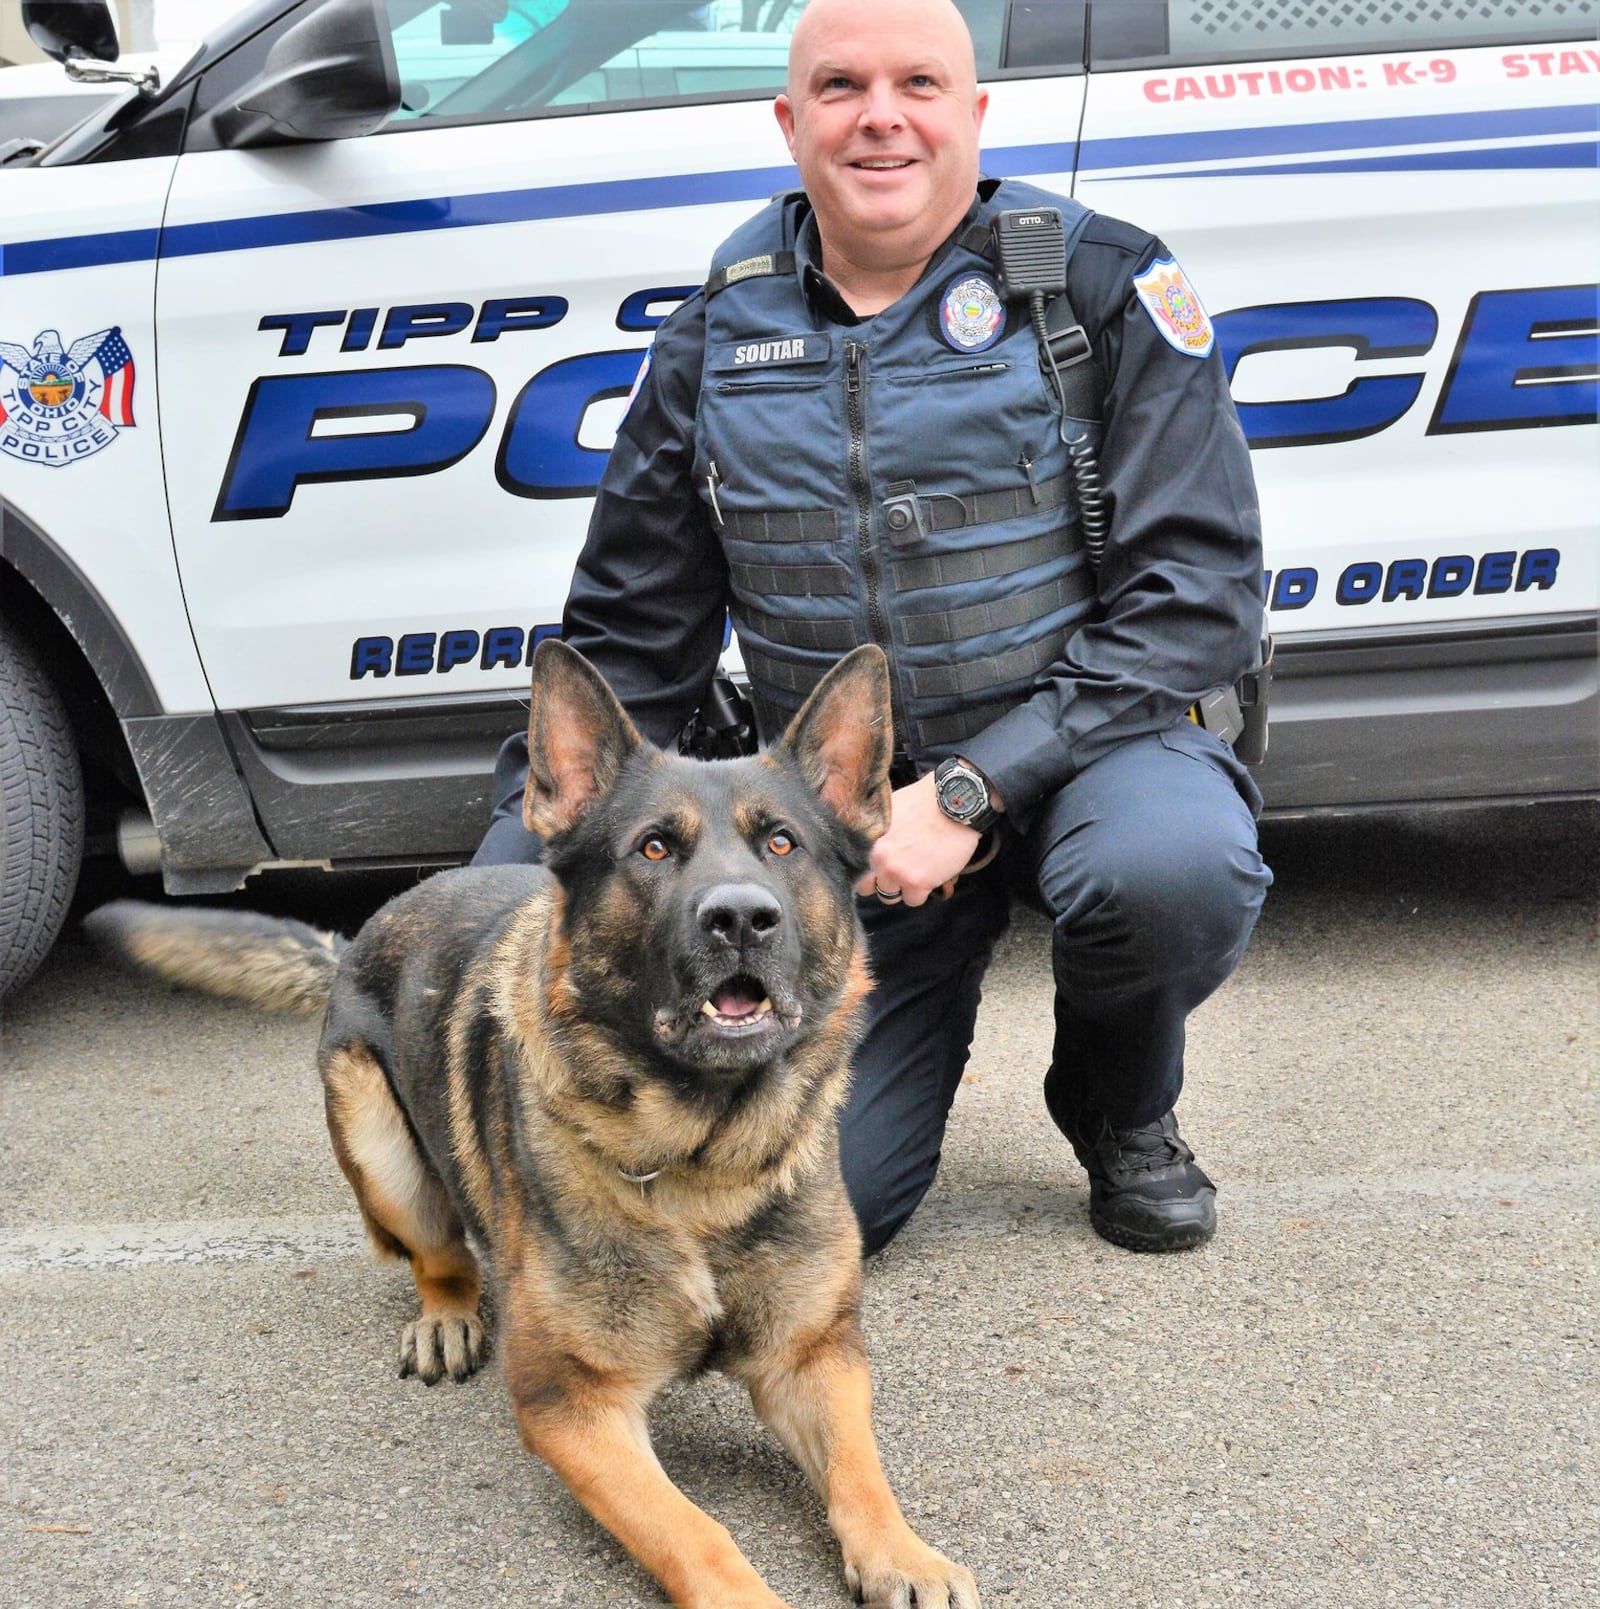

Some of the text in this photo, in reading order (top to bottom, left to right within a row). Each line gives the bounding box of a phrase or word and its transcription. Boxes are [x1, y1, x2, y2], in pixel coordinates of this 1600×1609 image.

[1142, 66, 1367, 103] CAUTION:
[1382, 59, 1457, 86] K-9
[258, 296, 569, 356] TIPP
[18, 353, 84, 390] STATE OF
[734, 339, 805, 364] SOUTAR
[3, 379, 102, 432] TIPP CITY
[30, 397, 79, 418] OHIO
[2, 429, 109, 458] POLICE
[1335, 548, 1560, 606] ORDER
